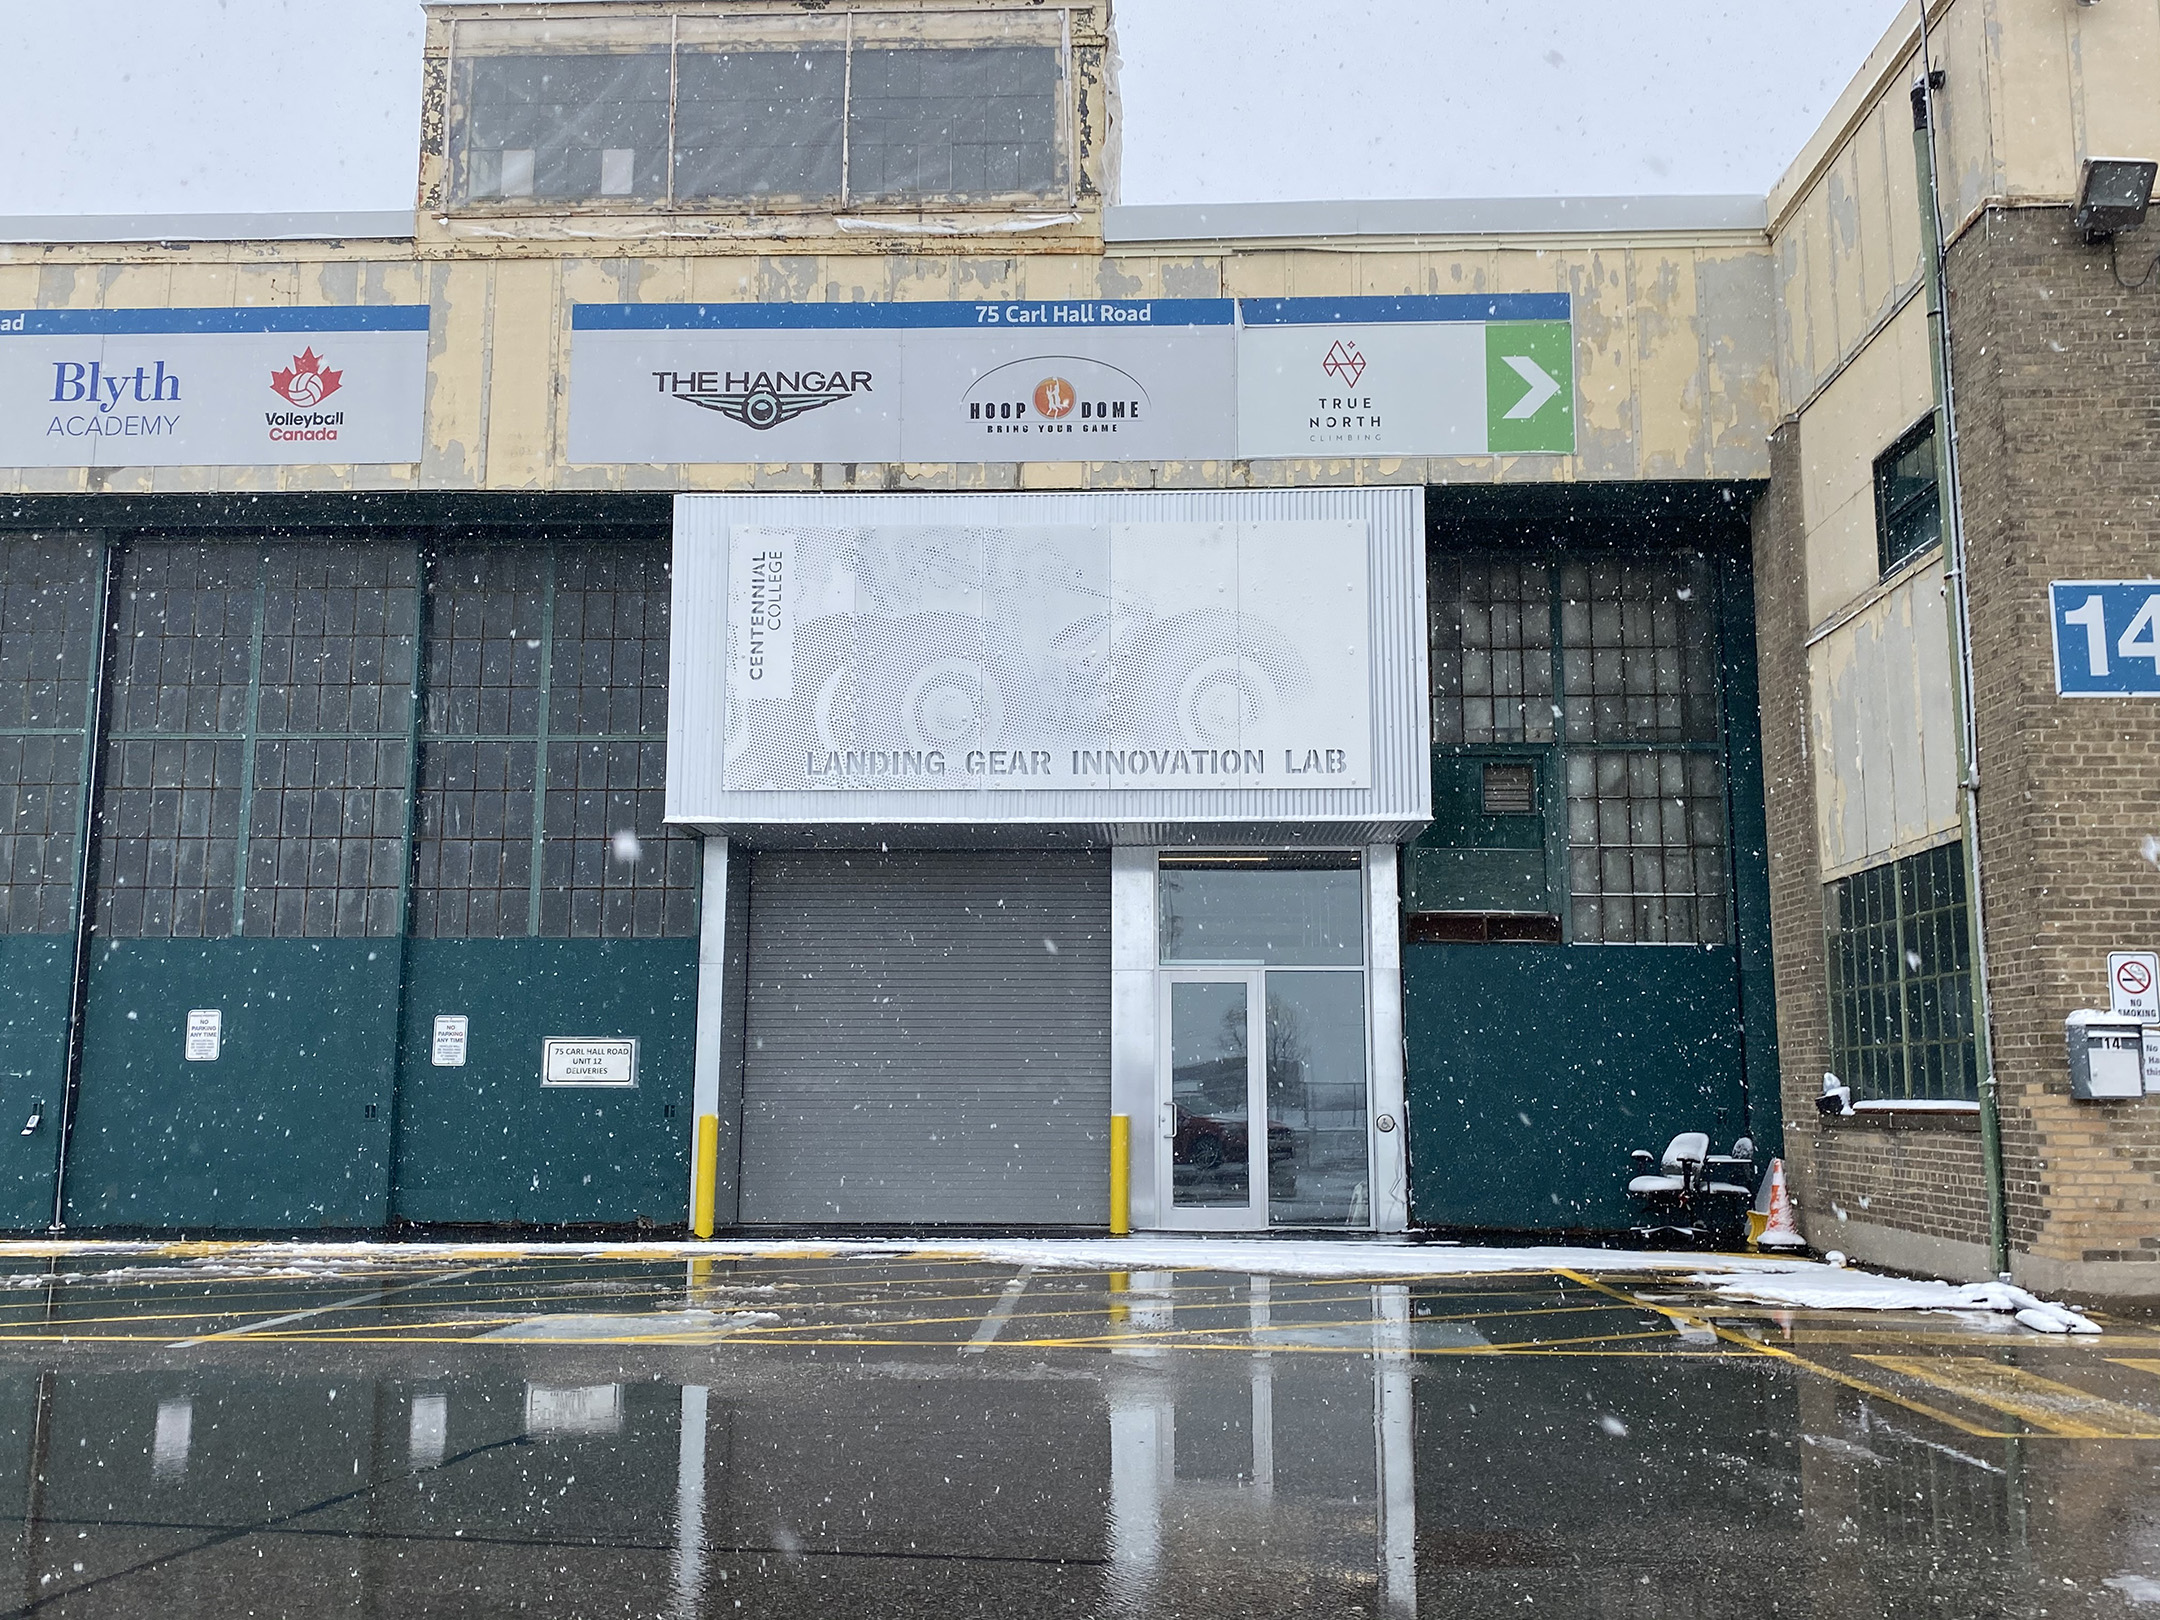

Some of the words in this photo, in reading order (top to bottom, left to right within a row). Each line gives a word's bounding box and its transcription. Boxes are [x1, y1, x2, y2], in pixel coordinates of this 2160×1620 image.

[0, 312, 25, 331] ad
[975, 305, 1000, 323] 75
[1005, 304, 1048, 323] Carl
[1053, 303, 1095, 323] Hall
[1100, 303, 1151, 322] Road
[49, 360, 182, 413] Blyth
[652, 371, 718, 393] THE
[725, 371, 873, 394] HANGAR
[970, 402, 1026, 420] HOOP
[1081, 401, 1139, 419] DOME
[1318, 397, 1371, 409] TRUE
[46, 415, 181, 436] ACADEMY
[265, 411, 344, 428] Volleyball
[1309, 416, 1381, 428] NORTH
[269, 427, 338, 441] Canada
[987, 425, 1029, 434] BRING
[1038, 424, 1074, 433] YOUR
[1082, 424, 1118, 433] GAME
[1309, 433, 1382, 442] CLIMBING
[767, 551, 783, 631] COLLEGE
[749, 551, 766, 681] CENTENNIAL
[2064, 593, 2160, 677] 14
[806, 750, 945, 777] LANDING
[965, 750, 1051, 776] GEAR
[1072, 750, 1265, 775] INNOVATION
[1285, 749, 1348, 774] LAB
[2130, 998, 2142, 1007] NO
[554, 1048, 564, 1056] 75
[565, 1048, 585, 1056] CARL
[586, 1048, 605, 1056] HALL
[606, 1048, 629, 1056] ROAD
[2104, 1037, 2121, 1050] 14
[566, 1067, 608, 1075] DELIVERIES
